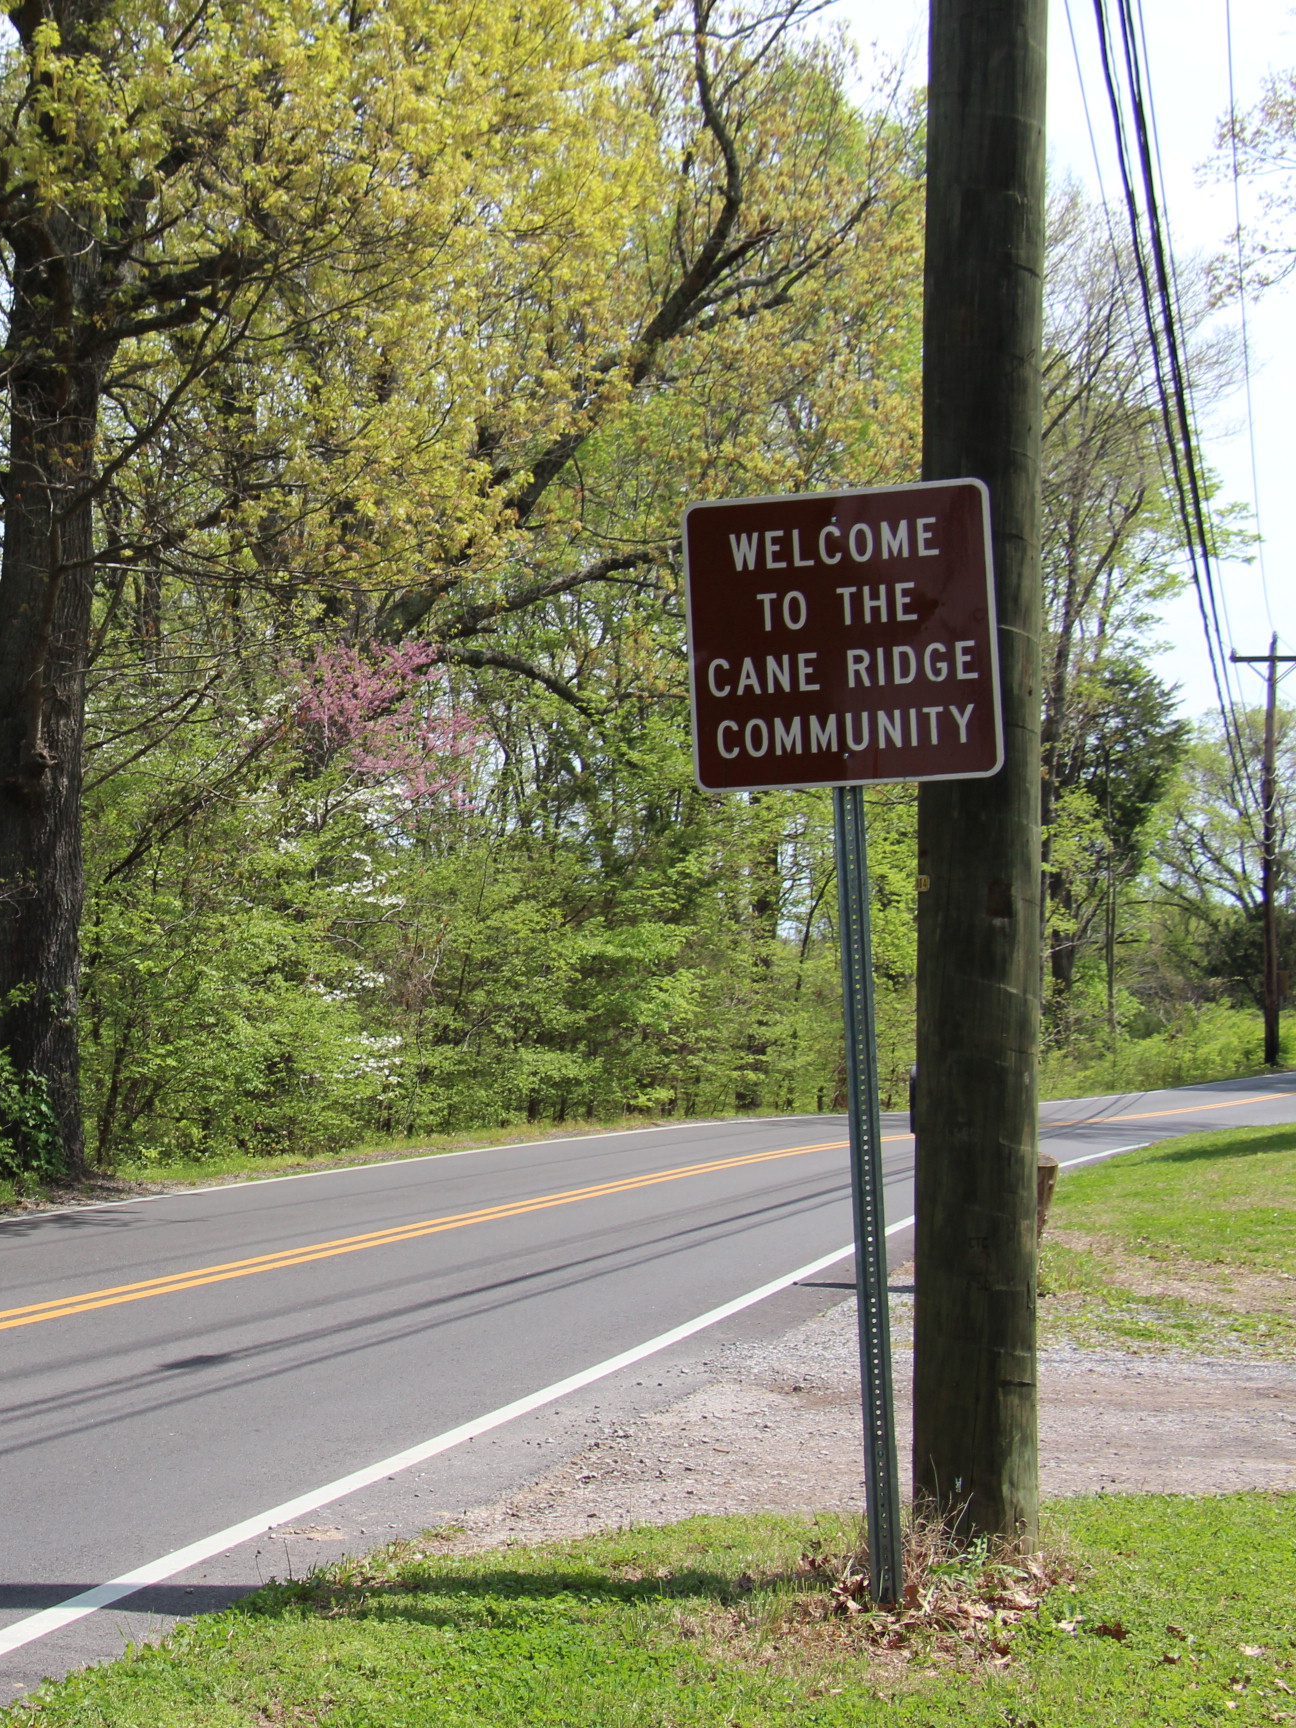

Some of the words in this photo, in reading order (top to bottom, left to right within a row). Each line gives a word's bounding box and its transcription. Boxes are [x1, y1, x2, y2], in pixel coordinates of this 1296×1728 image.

[729, 517, 940, 571] WELCOME
[757, 590, 807, 631] TO
[836, 581, 918, 625] THE
[708, 652, 820, 697] CANE
[847, 640, 979, 688] RIDGE
[717, 703, 974, 759] COMMUNITY
